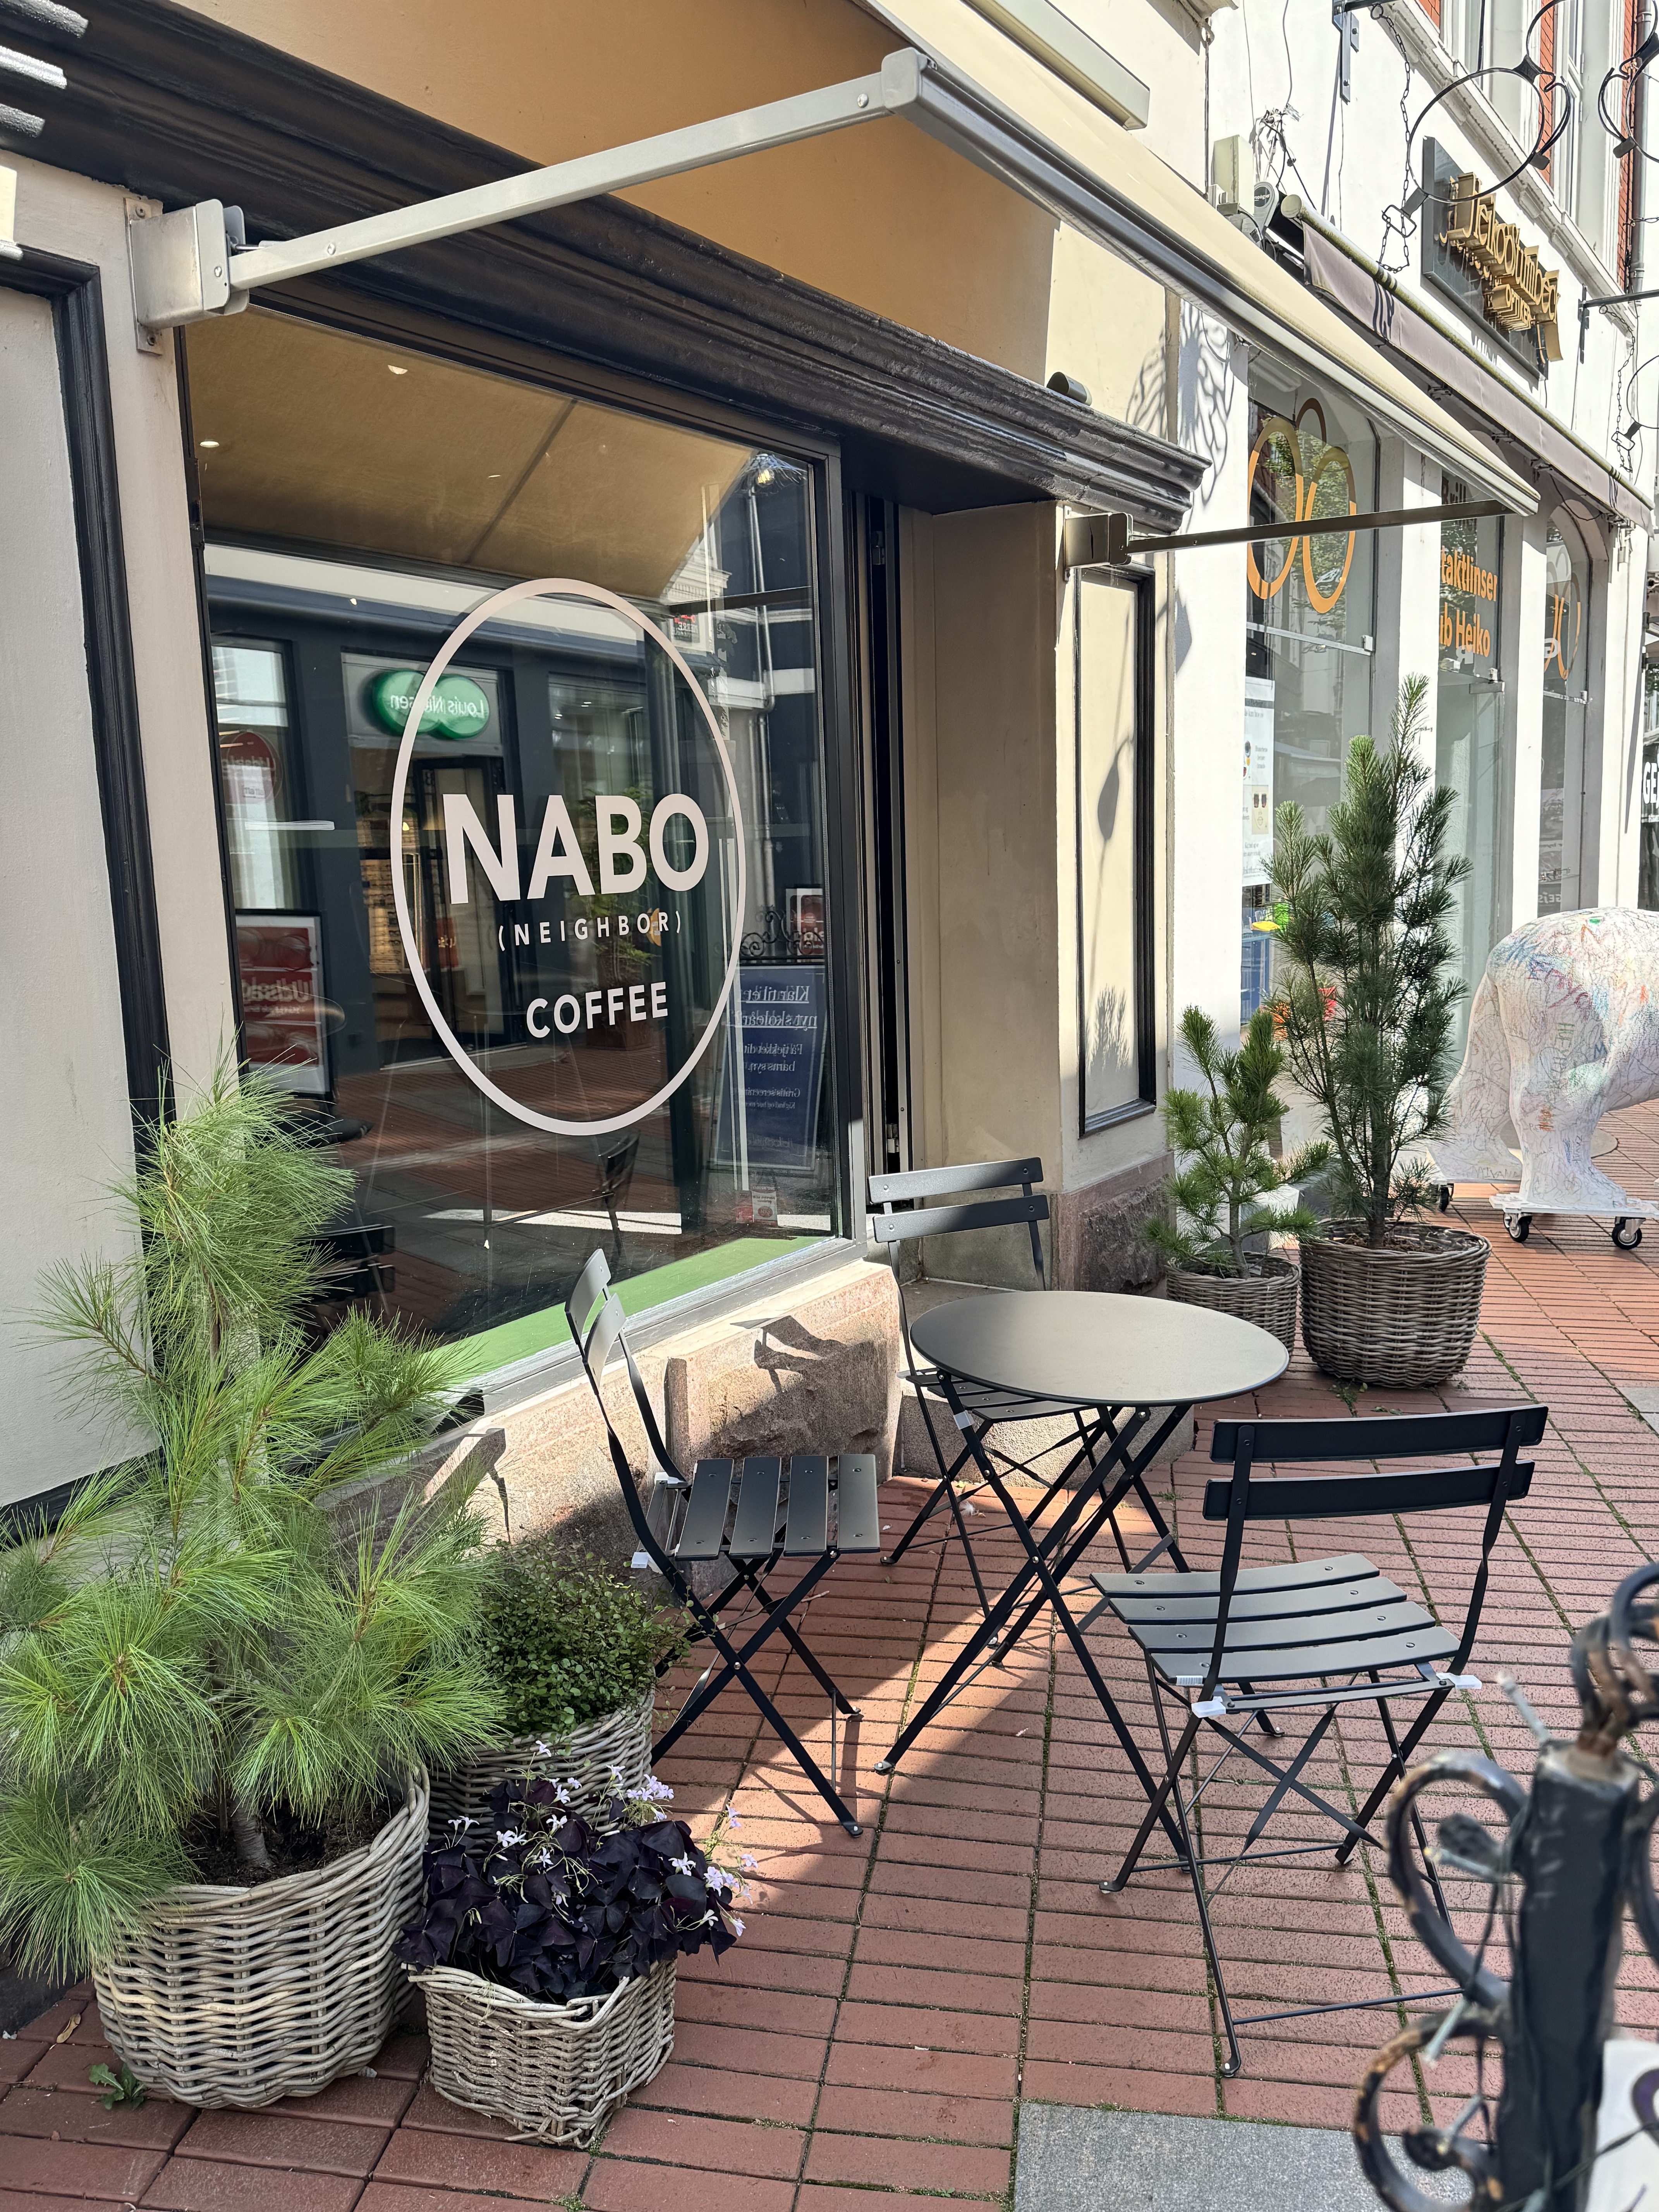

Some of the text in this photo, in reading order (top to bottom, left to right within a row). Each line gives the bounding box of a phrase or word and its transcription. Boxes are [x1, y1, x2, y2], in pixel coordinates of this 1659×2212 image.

[1504, 284, 1531, 327] OPTIKER
[1456, 609, 1490, 657] Heiko
[443, 793, 709, 904] NABO
[498, 910, 681, 951] (NEIGHBOR)
[527, 981, 668, 1038] COFFEE
